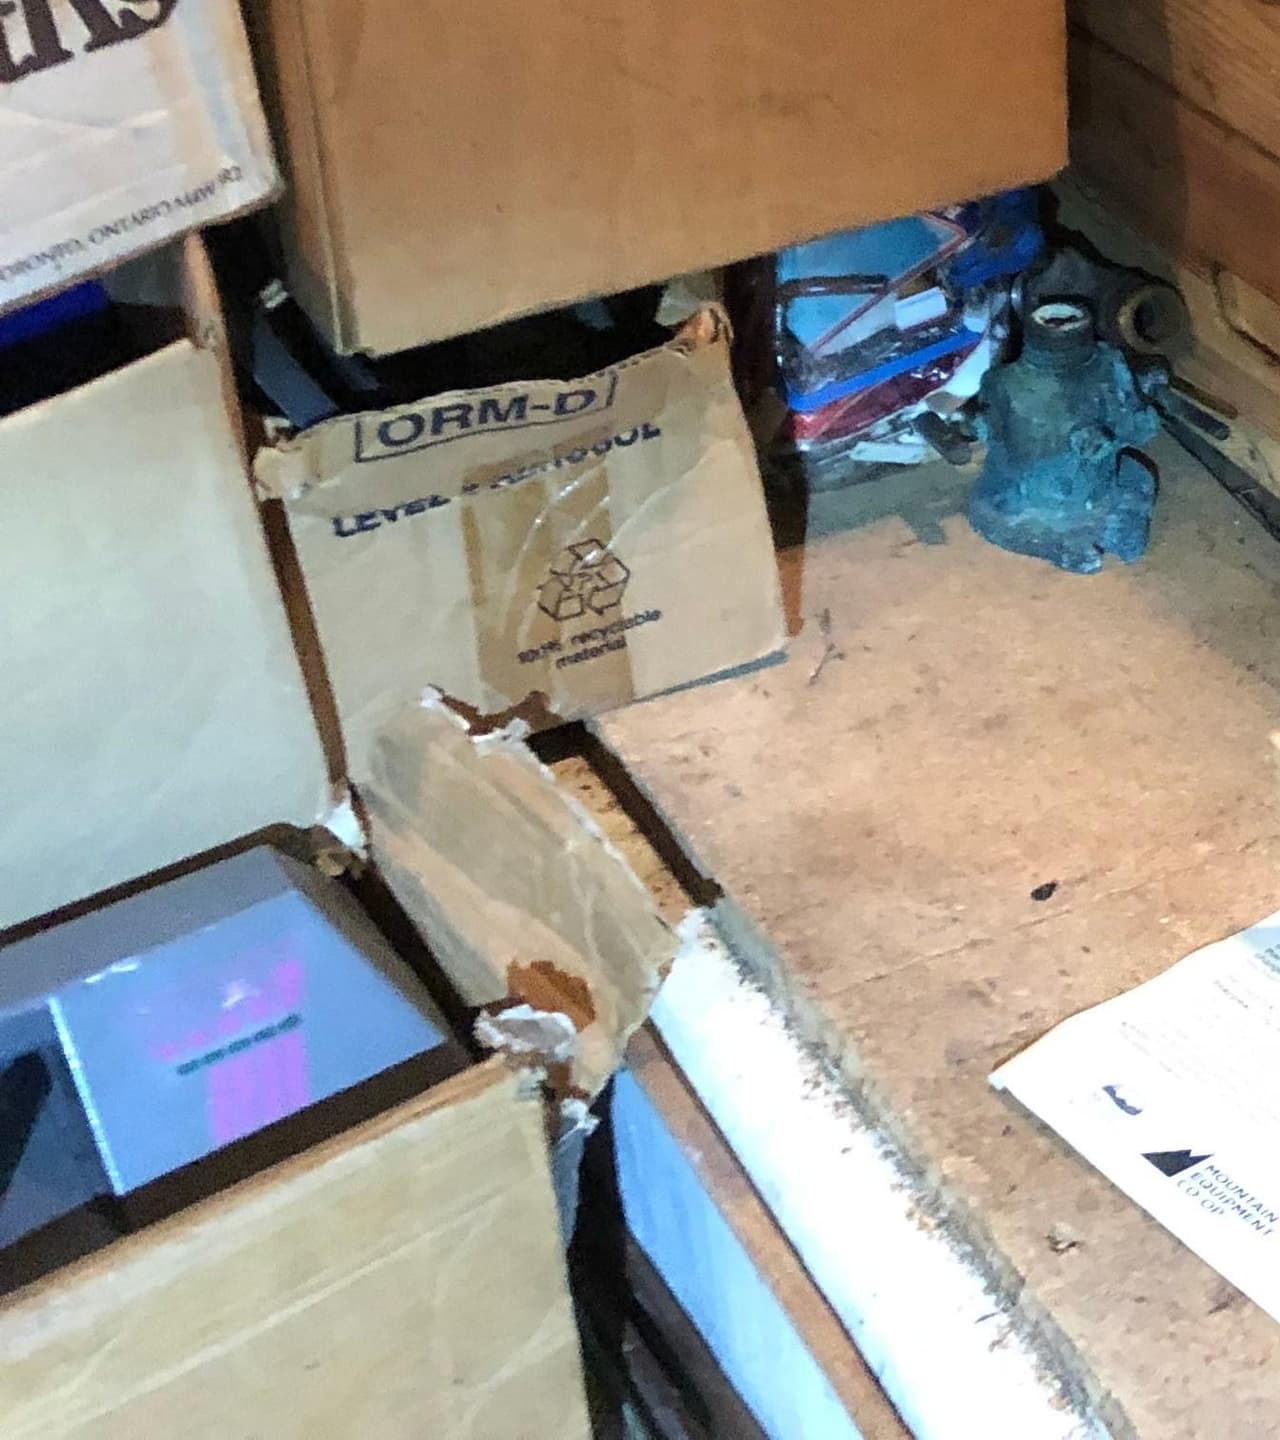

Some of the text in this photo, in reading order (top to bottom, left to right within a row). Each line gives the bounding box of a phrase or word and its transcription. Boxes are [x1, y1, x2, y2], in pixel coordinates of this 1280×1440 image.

[377, 388, 596, 448] ORM-D
[571, 609, 662, 645] recyclable
[1190, 1172, 1274, 1236] EQUIPMENT
[1205, 1164, 1279, 1223] MOUNTAIN
